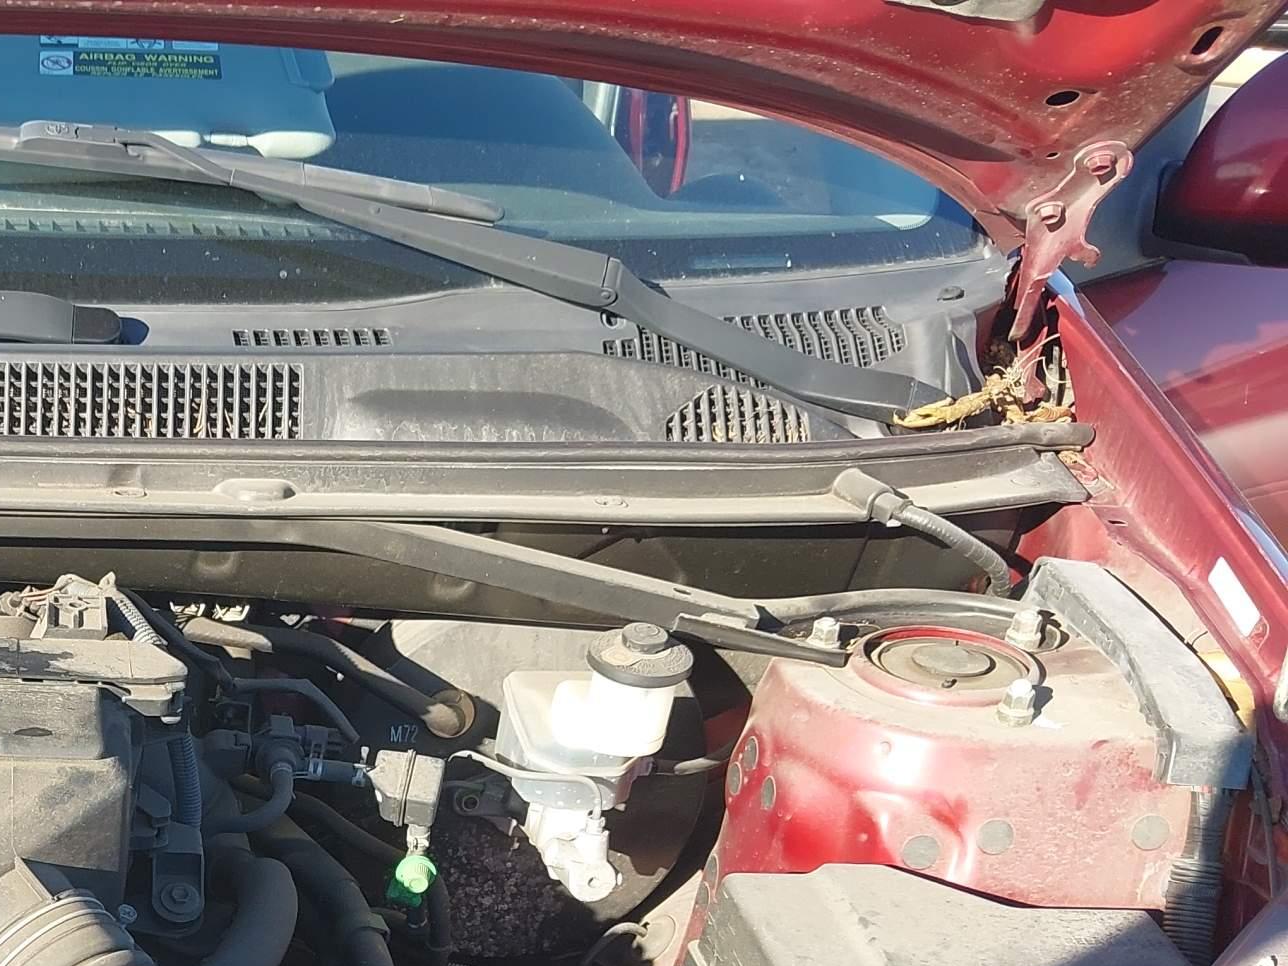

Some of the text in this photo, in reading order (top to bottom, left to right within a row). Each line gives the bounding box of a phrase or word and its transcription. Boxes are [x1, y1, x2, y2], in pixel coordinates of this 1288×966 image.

[79, 53, 214, 63] AIRBAG WARNING
[390, 724, 418, 744] M72
